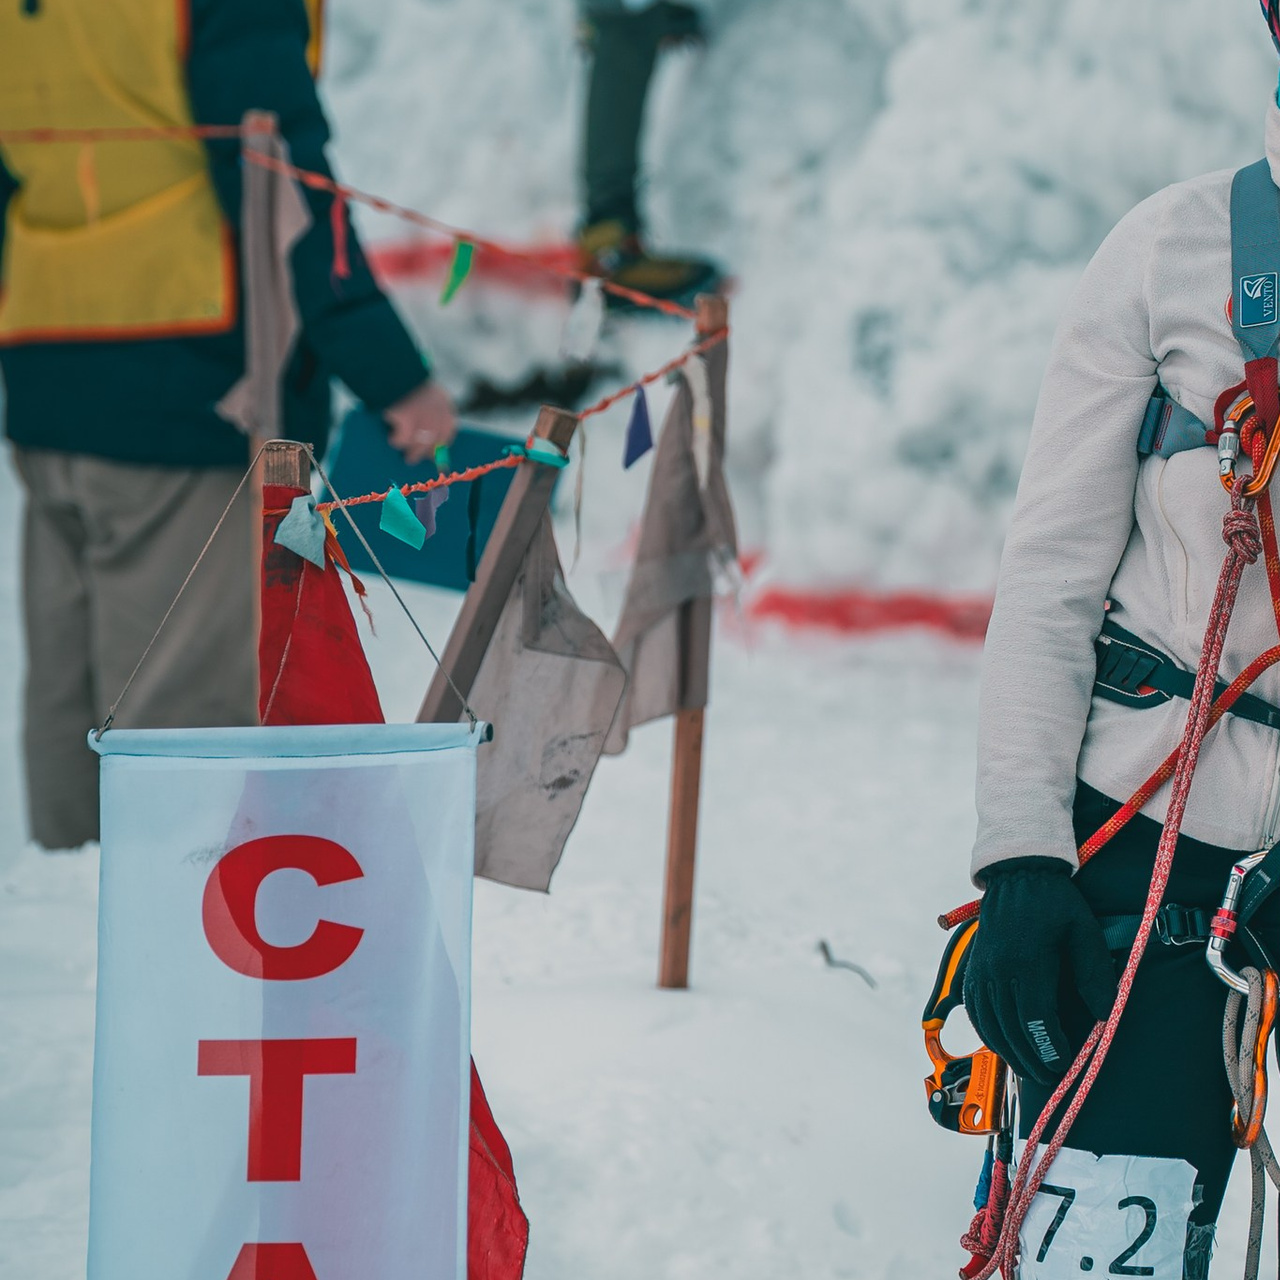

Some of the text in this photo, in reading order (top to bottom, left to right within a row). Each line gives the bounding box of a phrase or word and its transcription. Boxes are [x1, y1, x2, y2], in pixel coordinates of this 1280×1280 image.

[1263, 280, 1274, 317] VENTO
[1027, 1020, 1060, 1063] MAGNUM
[1036, 1183, 1157, 1276] 7.2
